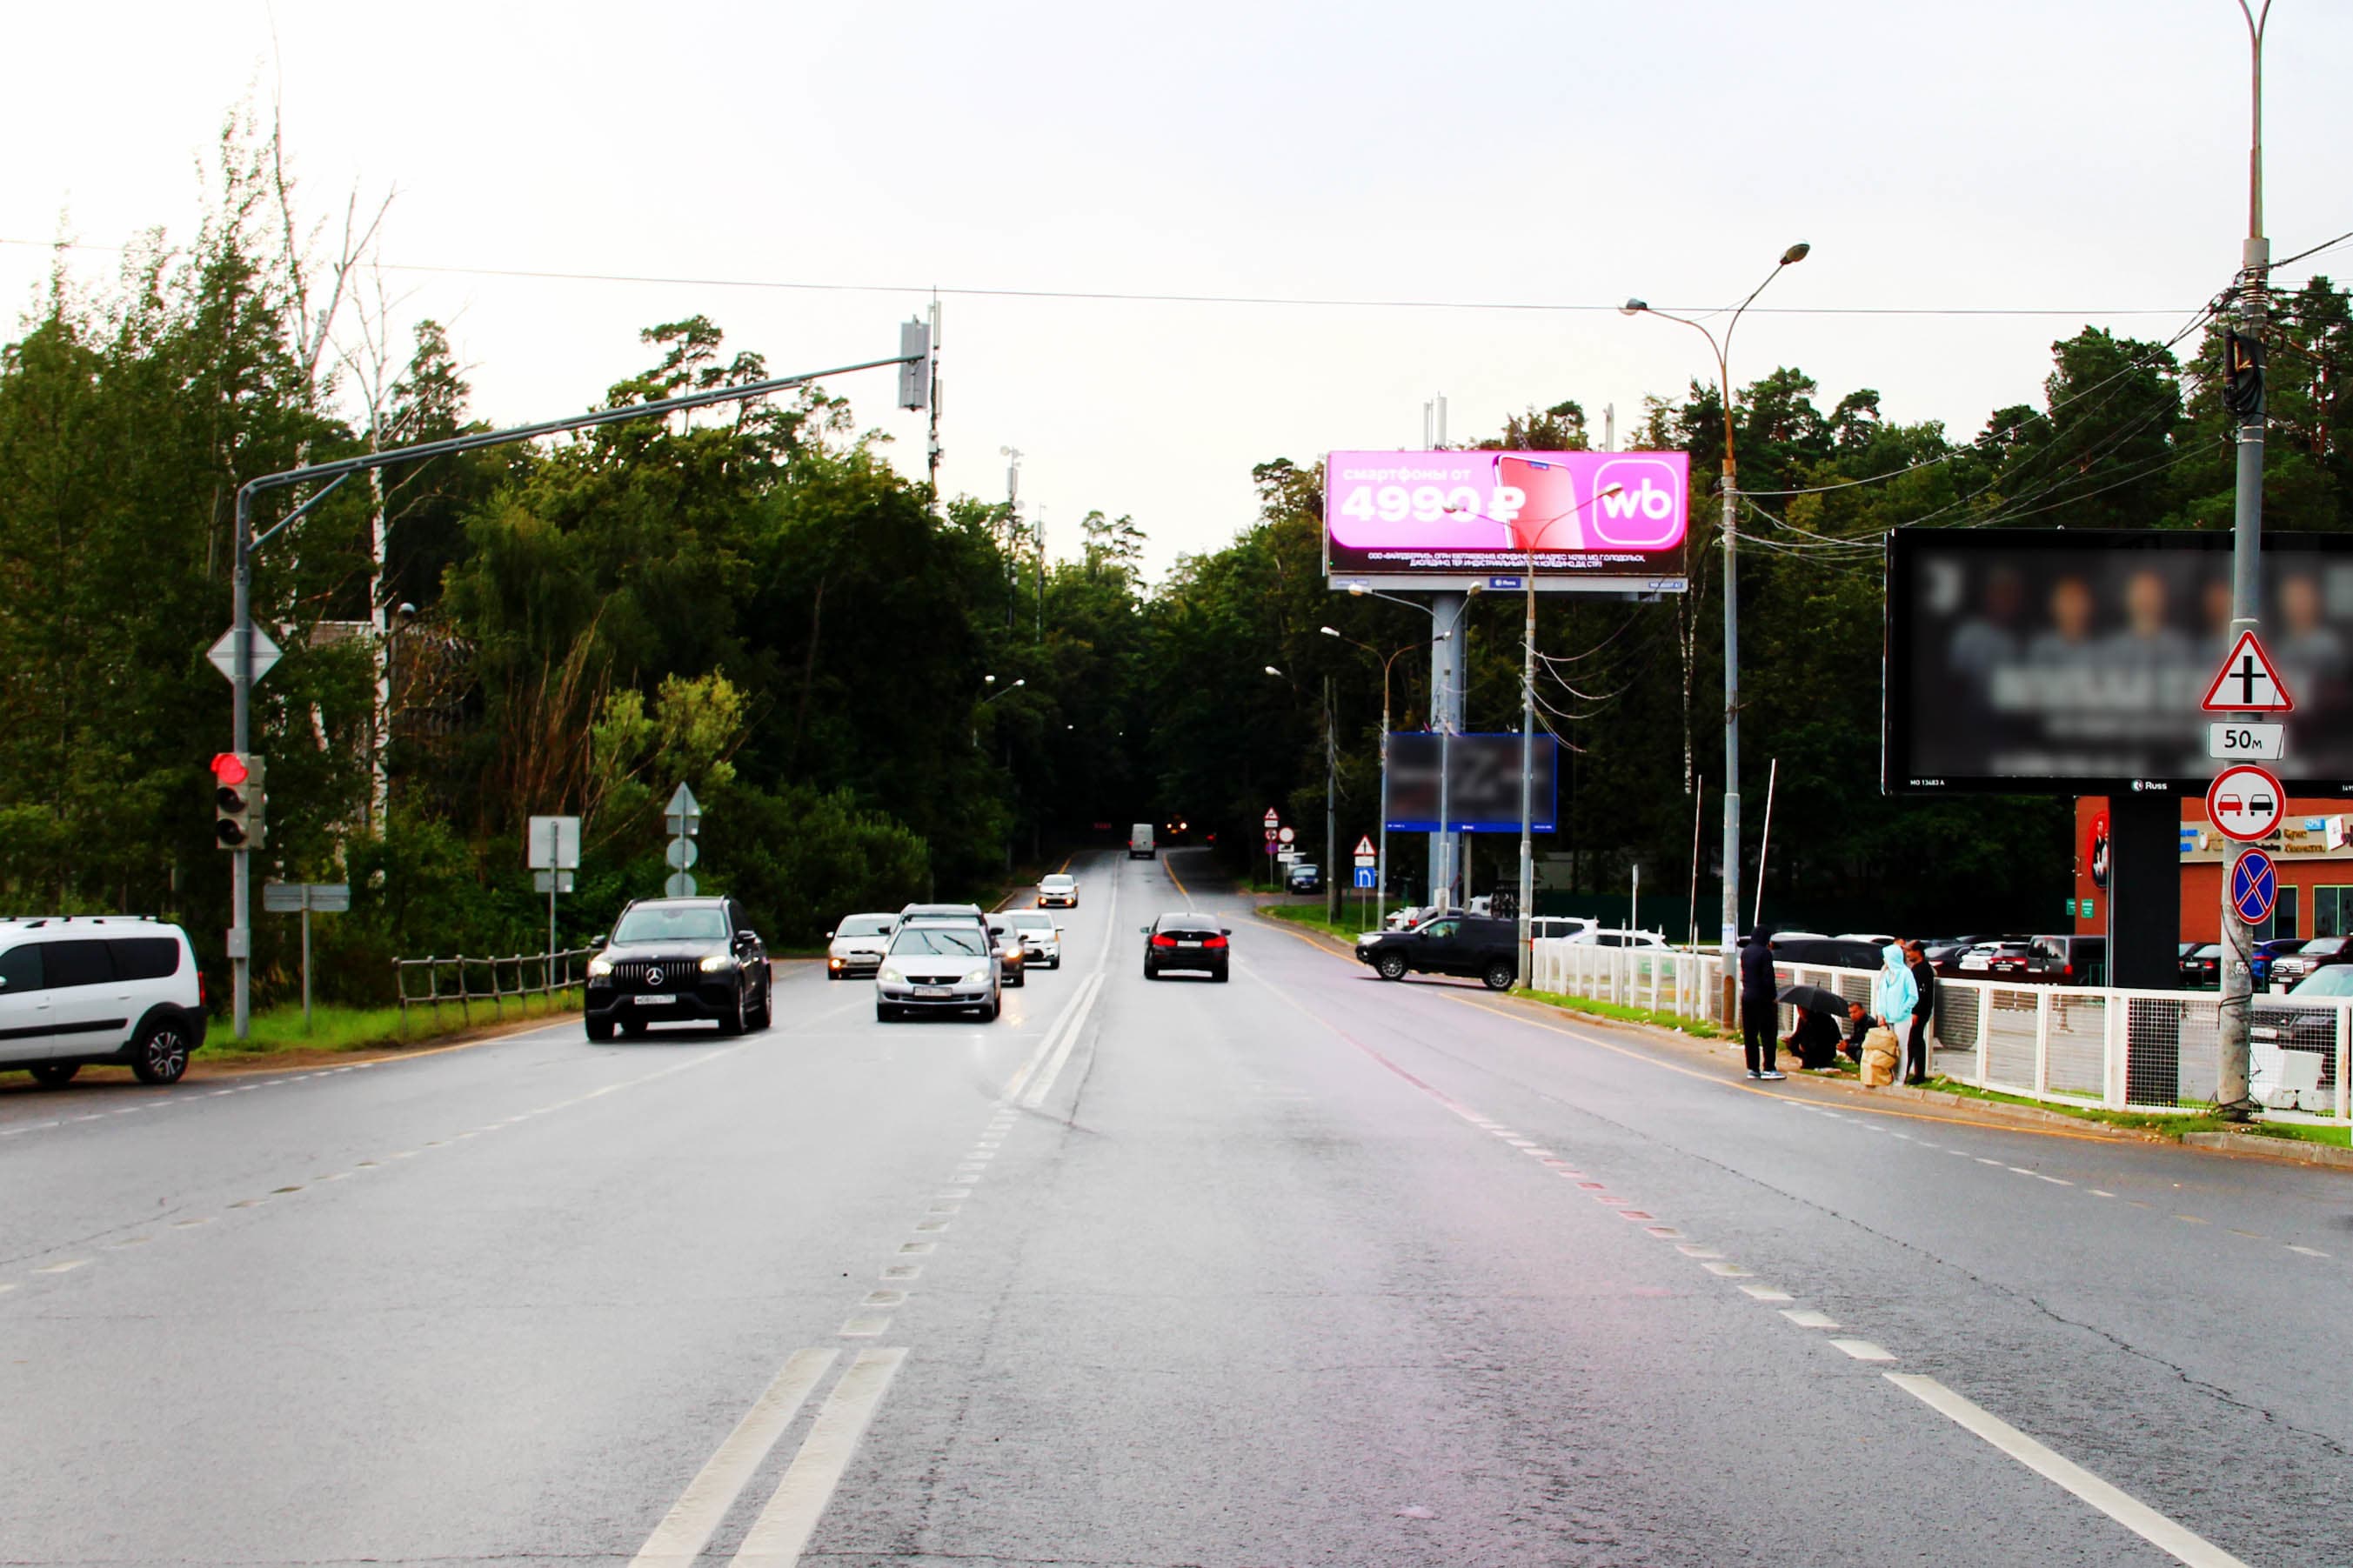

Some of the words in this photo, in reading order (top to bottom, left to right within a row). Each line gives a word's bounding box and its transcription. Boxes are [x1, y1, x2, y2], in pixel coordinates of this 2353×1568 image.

[1342, 467, 1448, 484] смартфоны
[1451, 469, 1472, 480] от
[1340, 485, 1481, 522] 4990
[1602, 477, 1673, 520] wb
[2145, 781, 2168, 790] Russ
